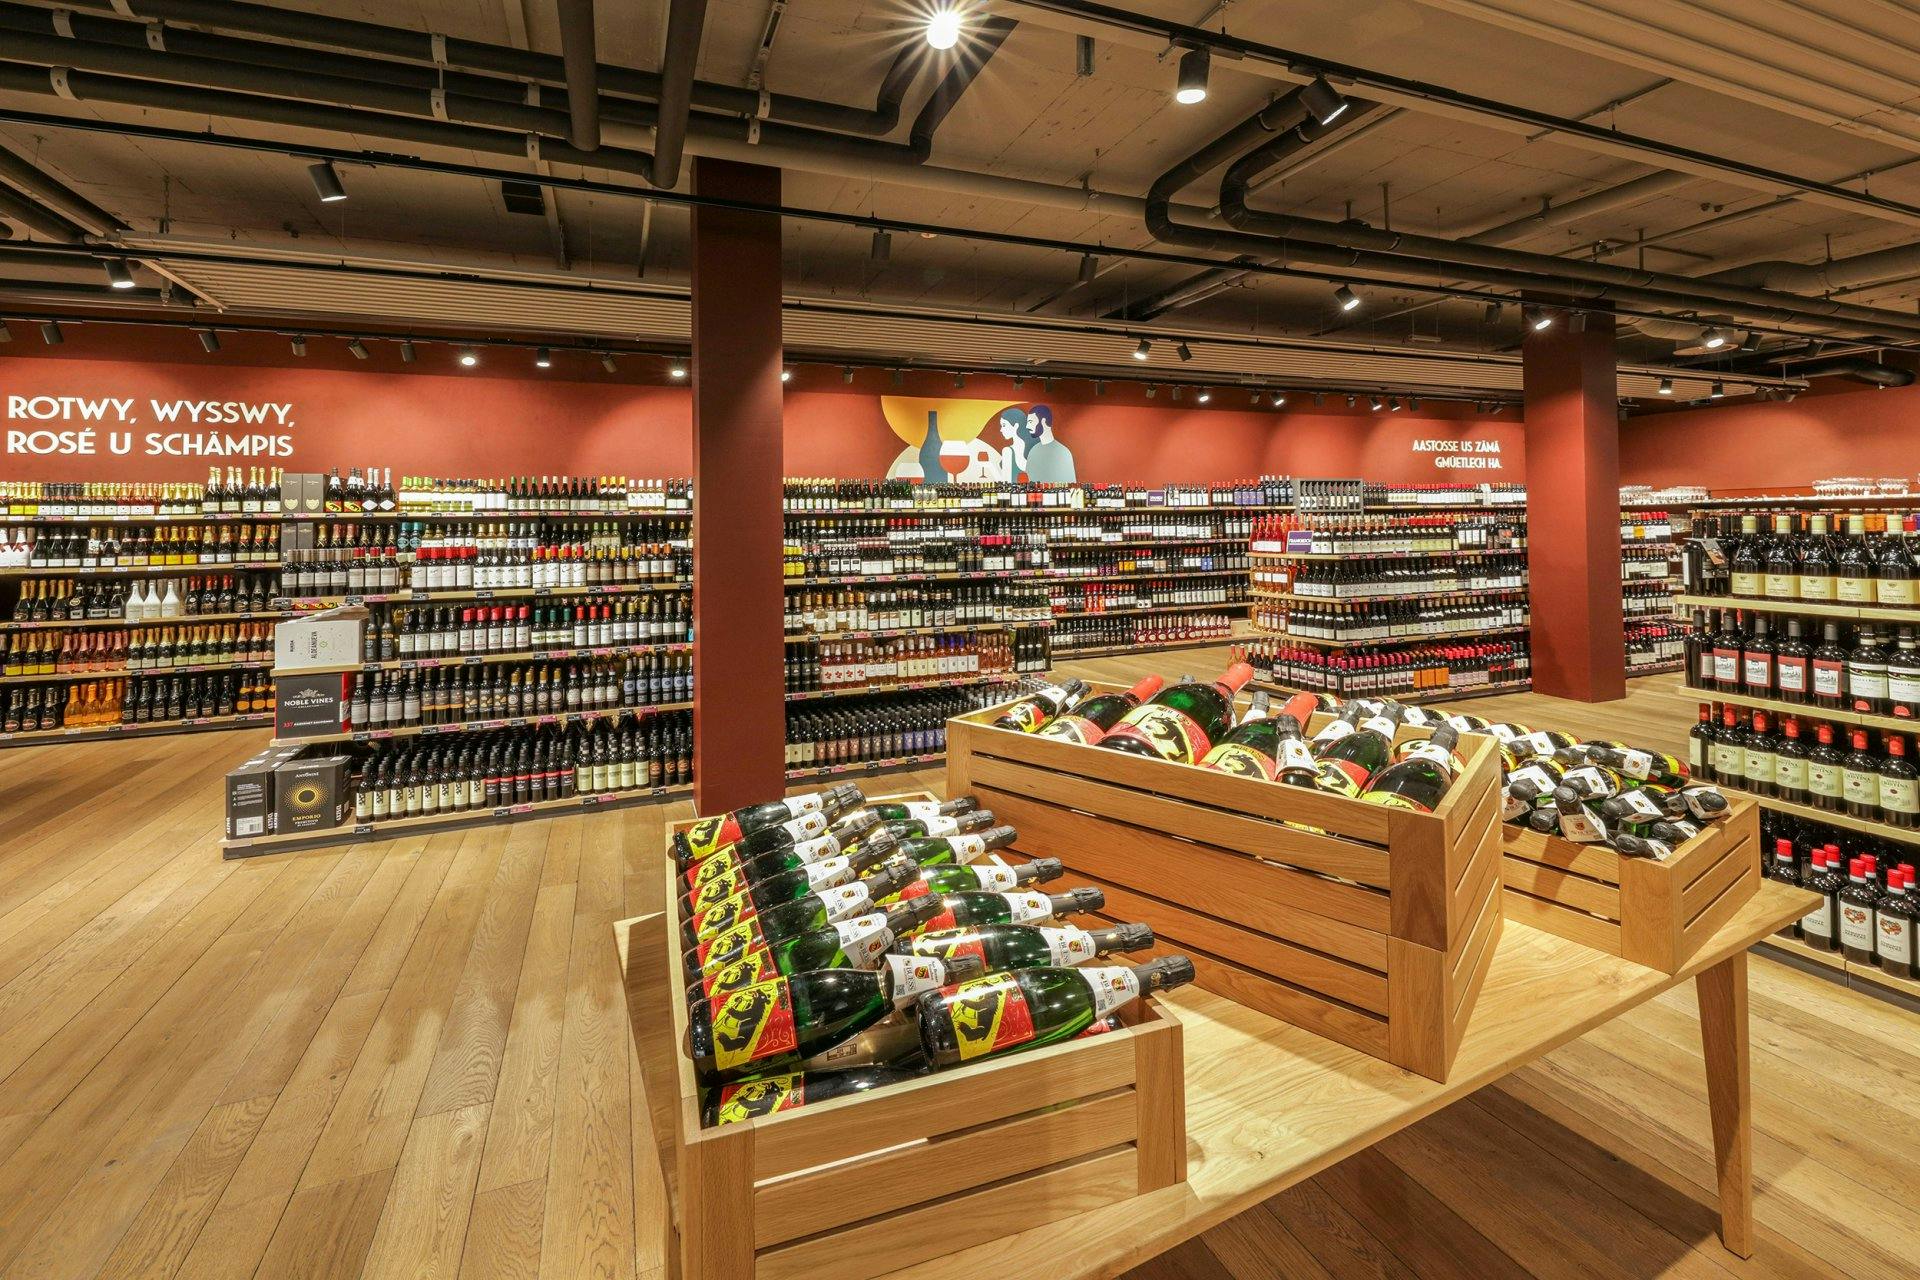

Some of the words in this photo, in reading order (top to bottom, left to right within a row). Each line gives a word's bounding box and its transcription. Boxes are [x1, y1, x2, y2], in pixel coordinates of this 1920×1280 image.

[8, 395, 137, 424] ROTWY,
[150, 399, 295, 427] WYSSWY,
[7, 427, 96, 454] ROSÉ
[109, 432, 132, 455] U
[145, 431, 294, 457] SCHÄMPIS
[1412, 440, 1459, 452] AASTOSSE
[1460, 440, 1473, 452] US
[1435, 455, 1486, 468] GMÜETLECH
[284, 699, 309, 707] NOBLE
[310, 697, 333, 705] VINES
[292, 813, 321, 821] EMPORIO
[905, 967, 916, 991] BUESS
